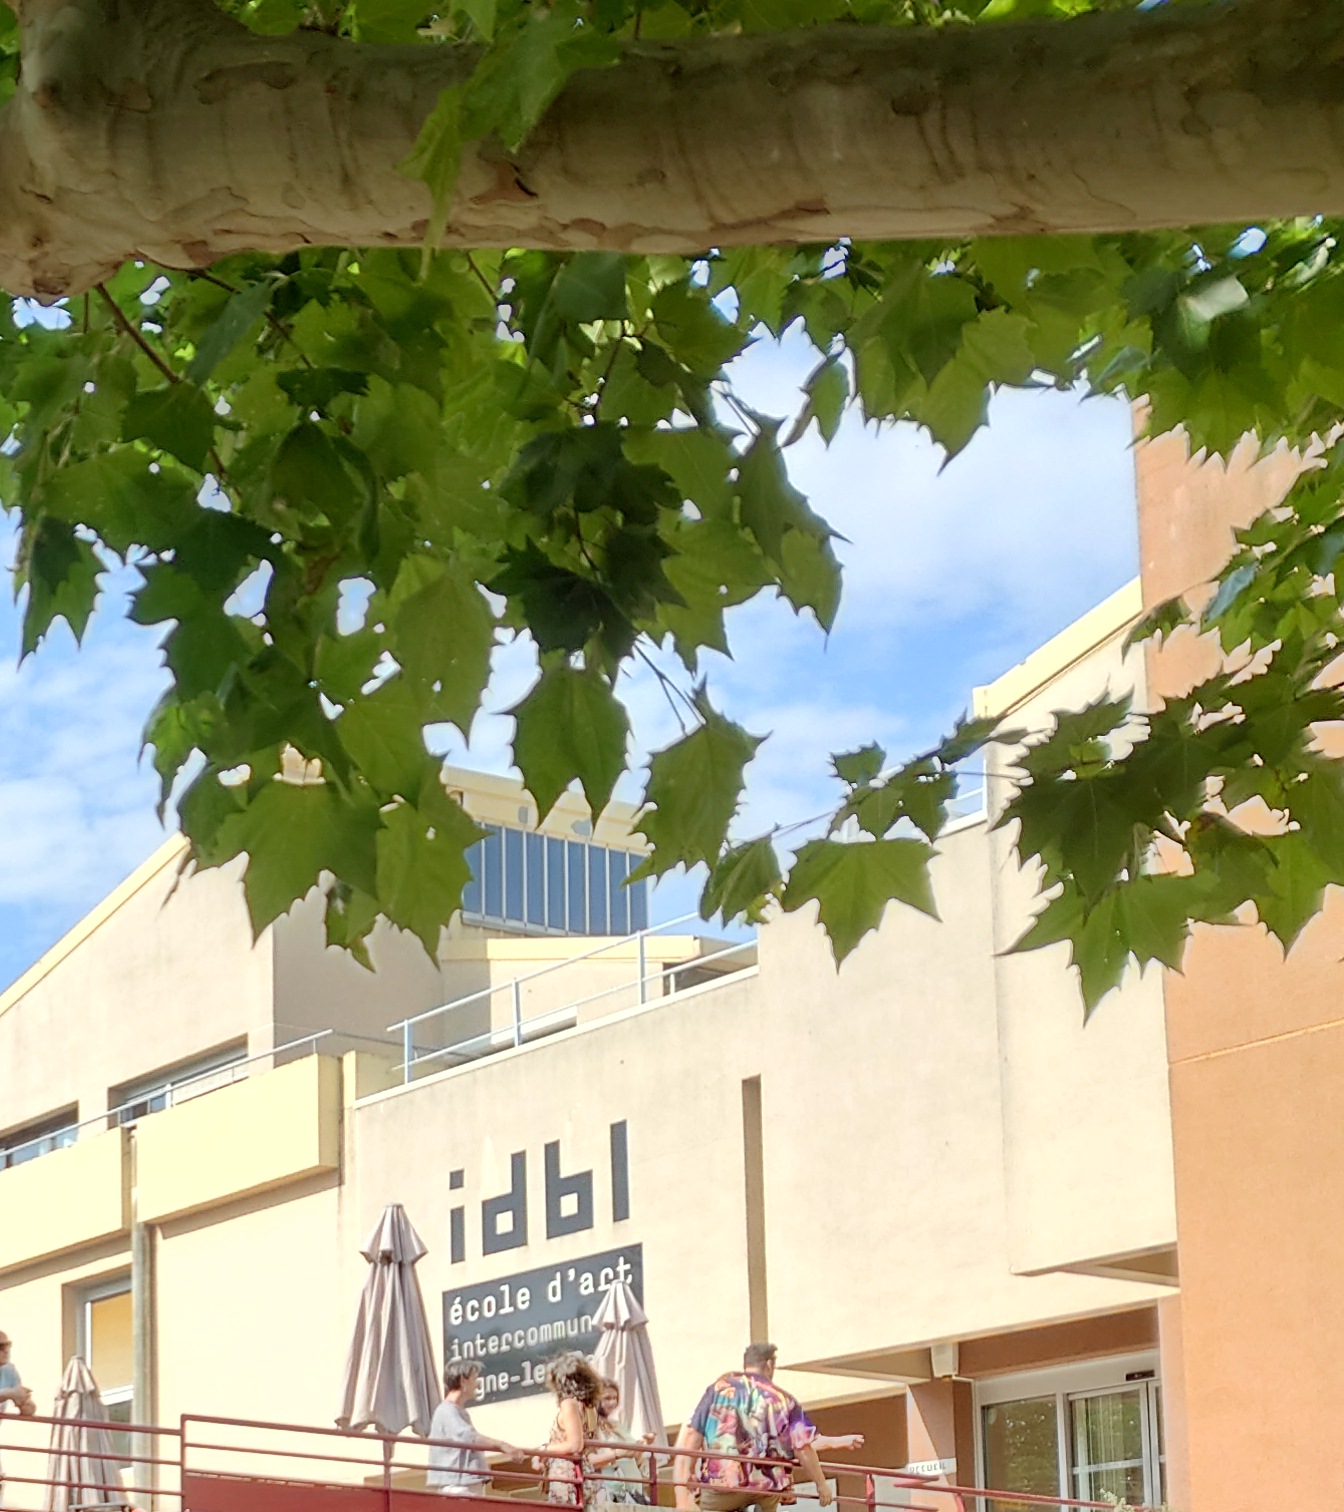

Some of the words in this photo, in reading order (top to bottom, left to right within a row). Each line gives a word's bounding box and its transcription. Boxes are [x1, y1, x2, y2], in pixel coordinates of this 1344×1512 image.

[449, 1119, 630, 1265] idbl
[450, 1284, 531, 1325] école
[548, 1256, 632, 1301] d'art
[450, 1313, 593, 1362] intercommun
